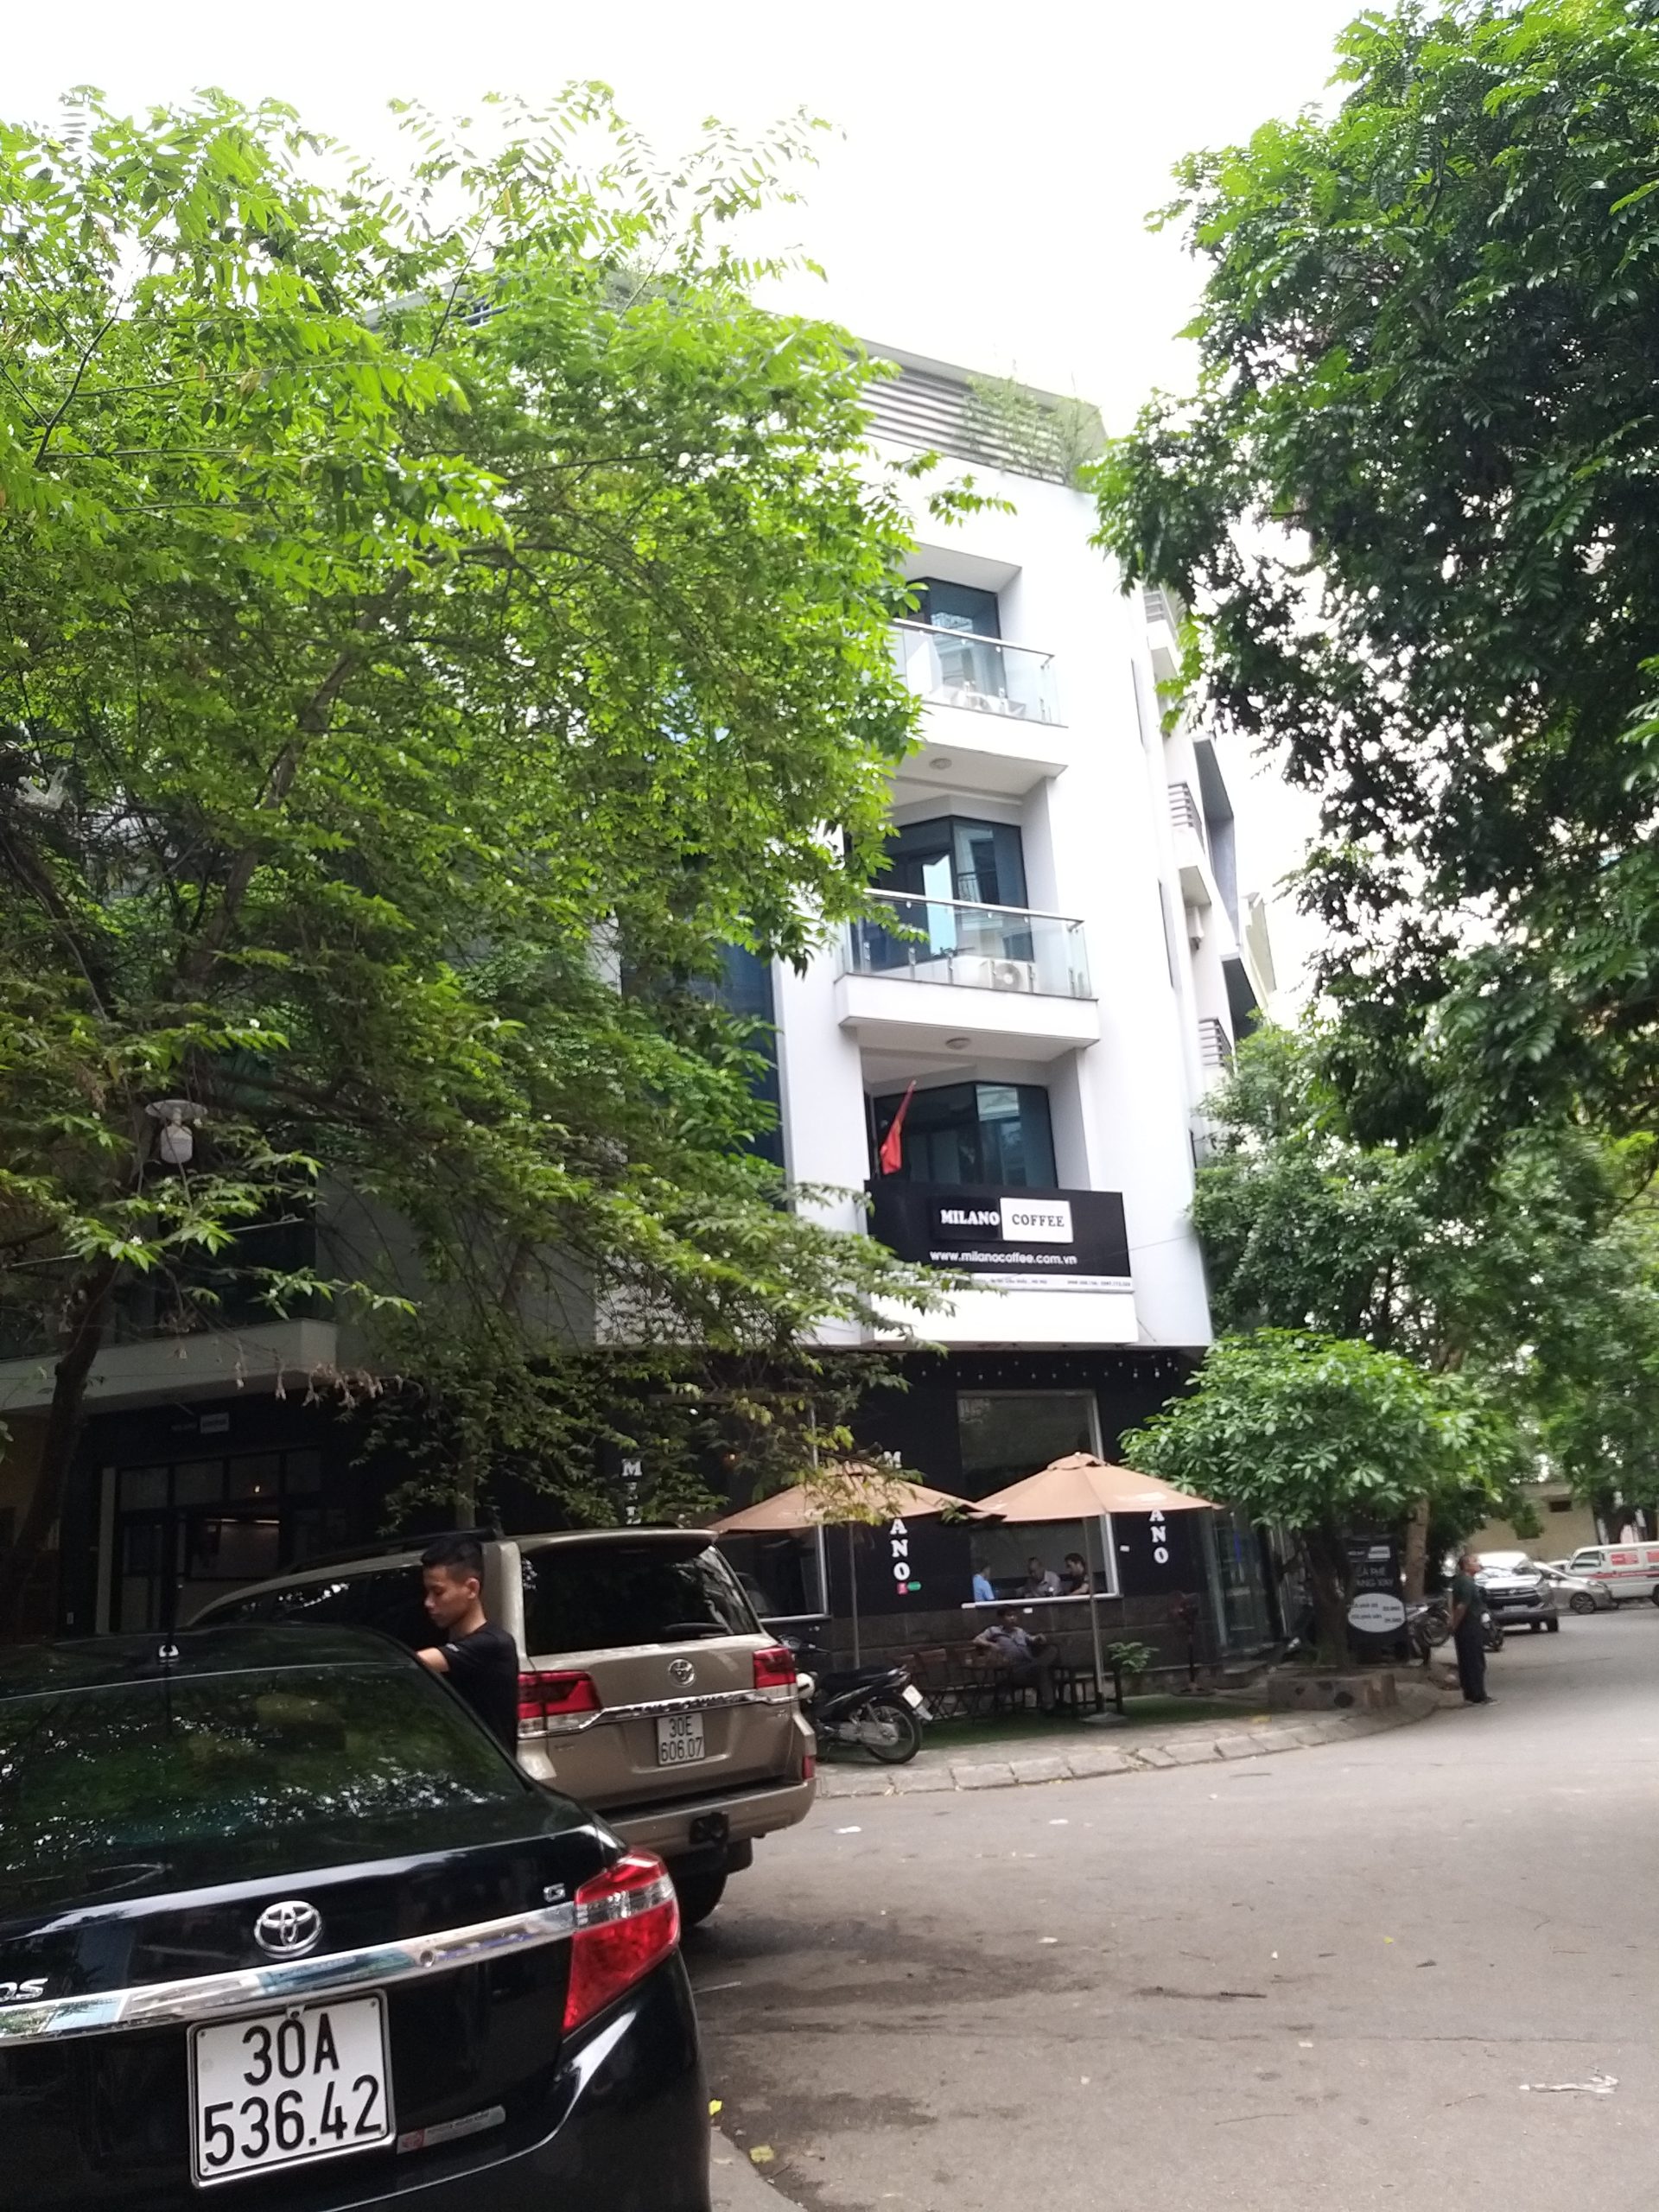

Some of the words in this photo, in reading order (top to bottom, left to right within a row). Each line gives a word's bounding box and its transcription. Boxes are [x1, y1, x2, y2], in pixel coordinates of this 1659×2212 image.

[940, 1209, 1001, 1226] MILANO
[1012, 1213, 1065, 1228] COFFEE
[929, 1250, 1077, 1265] www.milanocoffee.com.vn
[669, 1715, 694, 1738] 30E
[661, 1736, 703, 1762] 606.07
[242, 2012, 340, 2086] 30A
[204, 2074, 382, 2166] 536.42
